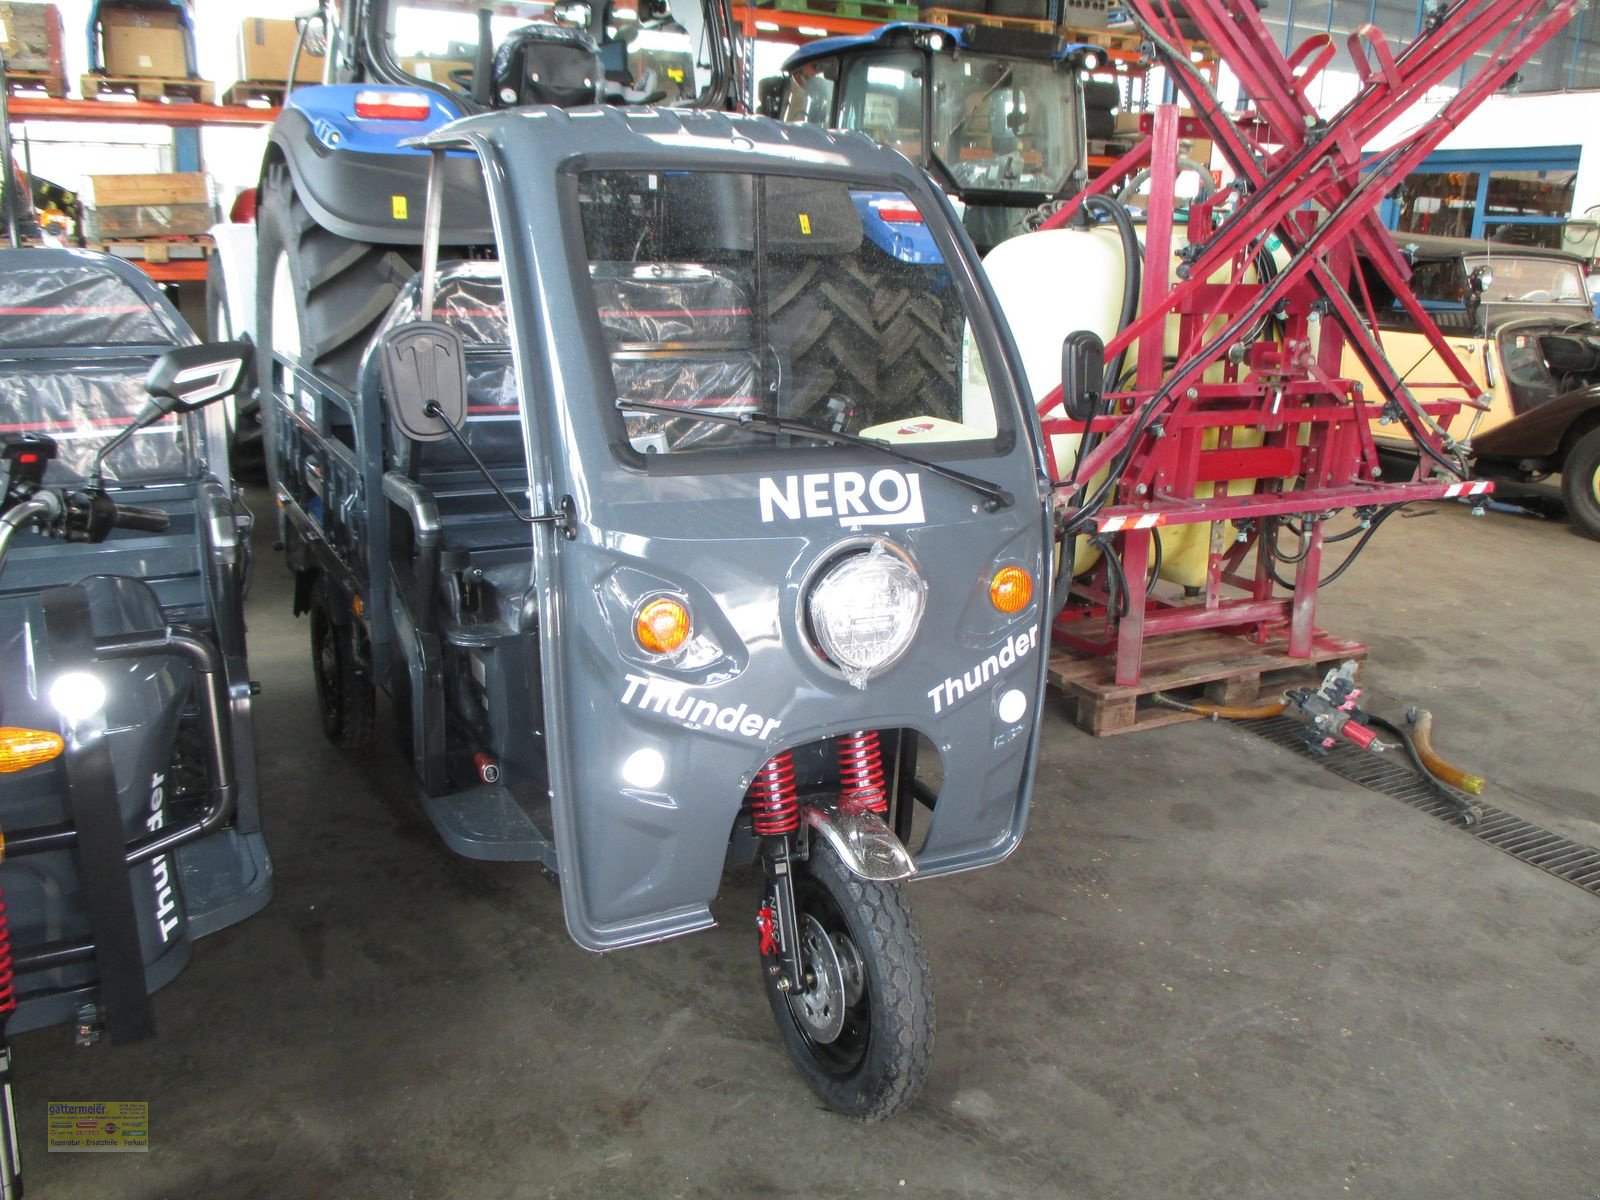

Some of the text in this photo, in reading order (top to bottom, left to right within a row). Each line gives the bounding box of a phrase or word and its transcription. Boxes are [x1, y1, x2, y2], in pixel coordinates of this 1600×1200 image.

[760, 469, 926, 527] NERO
[928, 623, 1038, 714] Thunder
[621, 674, 782, 740] Thunder
[147, 772, 179, 943] Thuder
[769, 896, 780, 943] NERO
